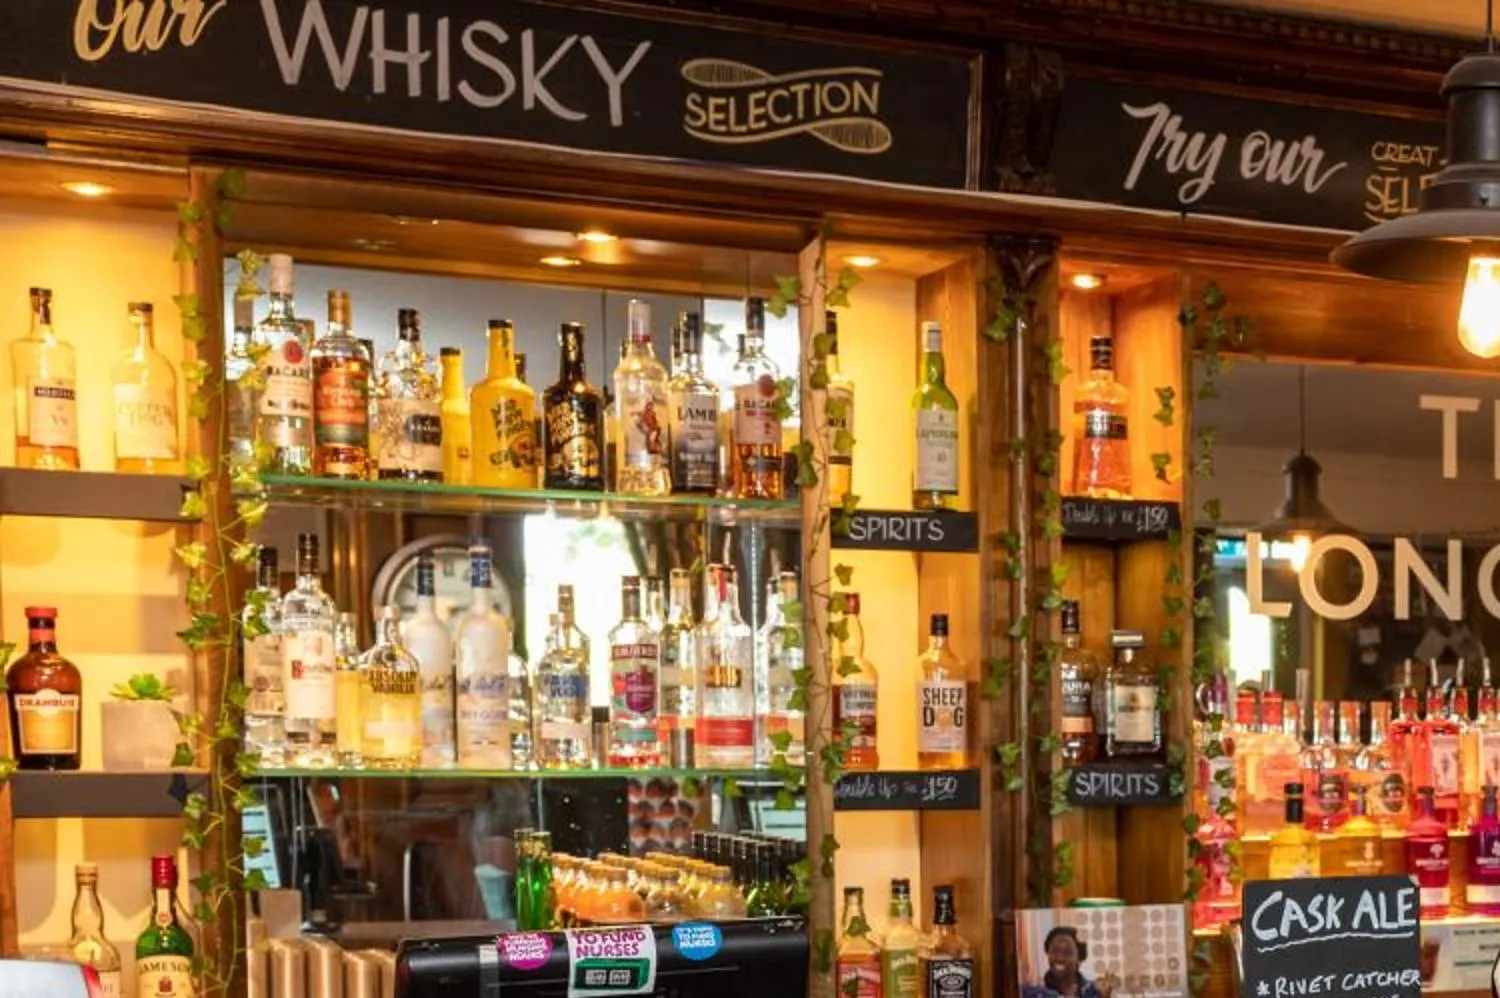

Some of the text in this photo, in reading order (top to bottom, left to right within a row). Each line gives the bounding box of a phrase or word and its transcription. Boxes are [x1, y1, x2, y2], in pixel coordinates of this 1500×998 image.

[72, 0, 881, 133] Our WHISKY SELECTION
[1122, 101, 1228, 199] Try
[1239, 131, 1346, 194] our
[849, 516, 945, 541] SPIRITS
[1075, 771, 1160, 797] SPIRITS
[1252, 888, 1416, 941] CASK ALE
[575, 943, 640, 958] NURSES
[602, 930, 647, 944] FUND
[1275, 969, 1421, 998] RIVET CATCHER
